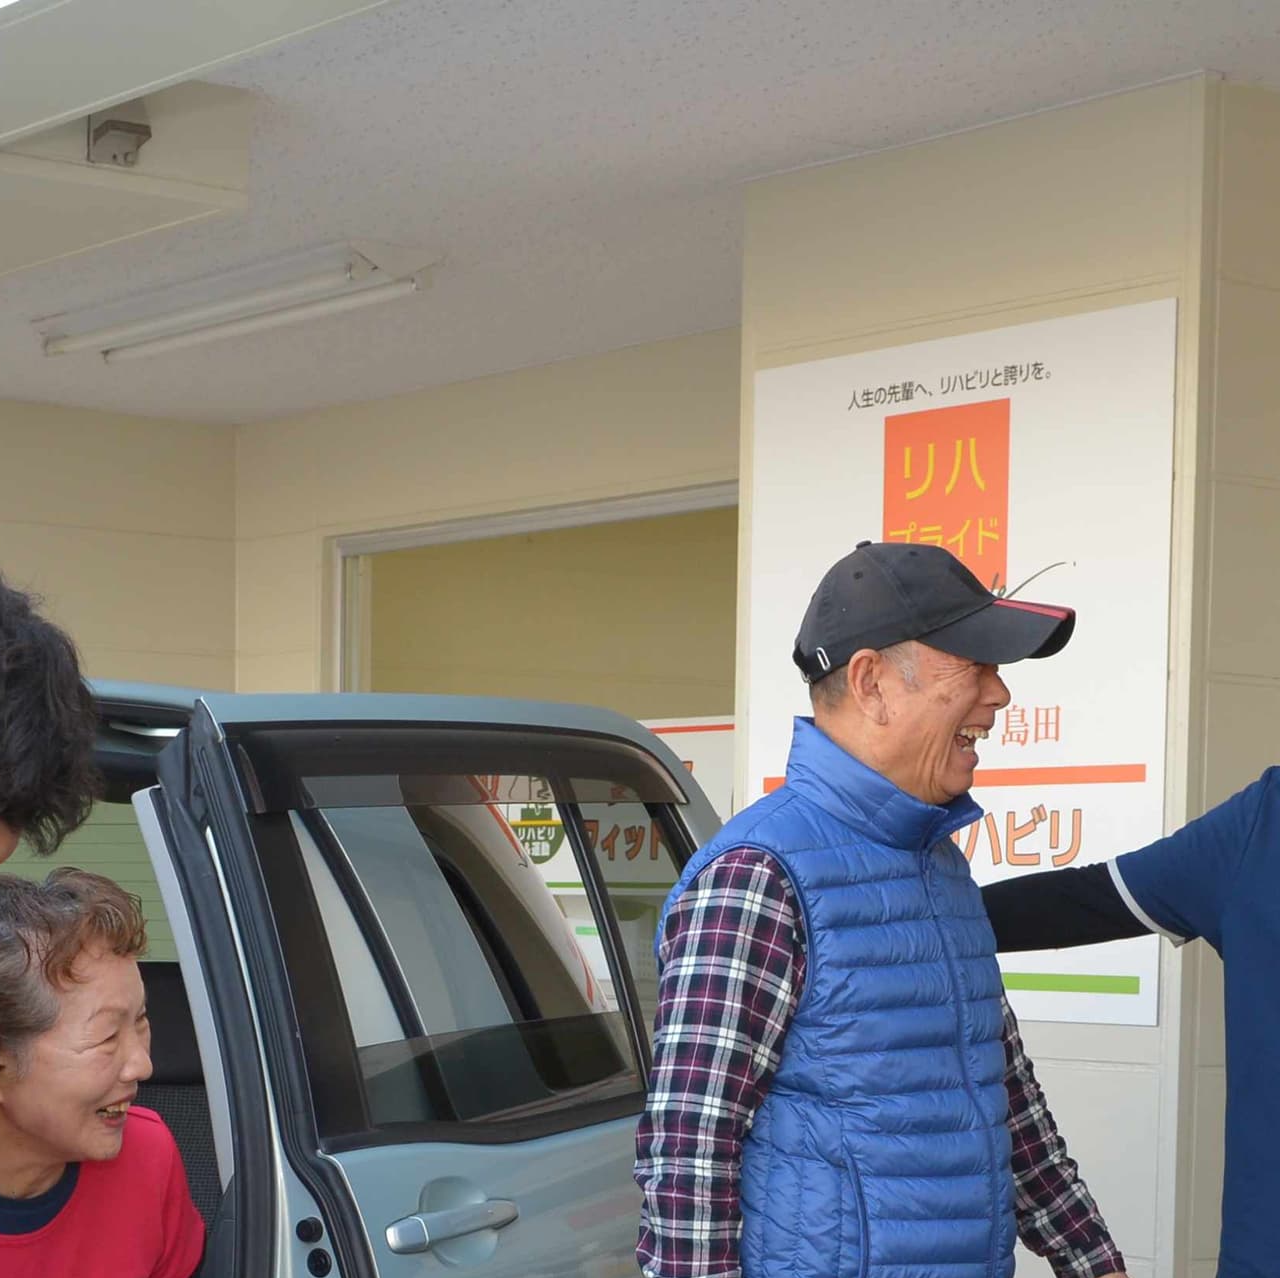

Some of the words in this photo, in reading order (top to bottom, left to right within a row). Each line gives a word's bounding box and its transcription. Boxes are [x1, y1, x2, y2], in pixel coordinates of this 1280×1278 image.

[848, 362, 1051, 411] 人生の先輩へ、リハビリと誇りを。
[903, 437, 987, 500] リハ
[1001, 704, 1061, 746] 島田
[517, 826, 556, 841] リハビリ
[951, 803, 1083, 868] ハビリ
